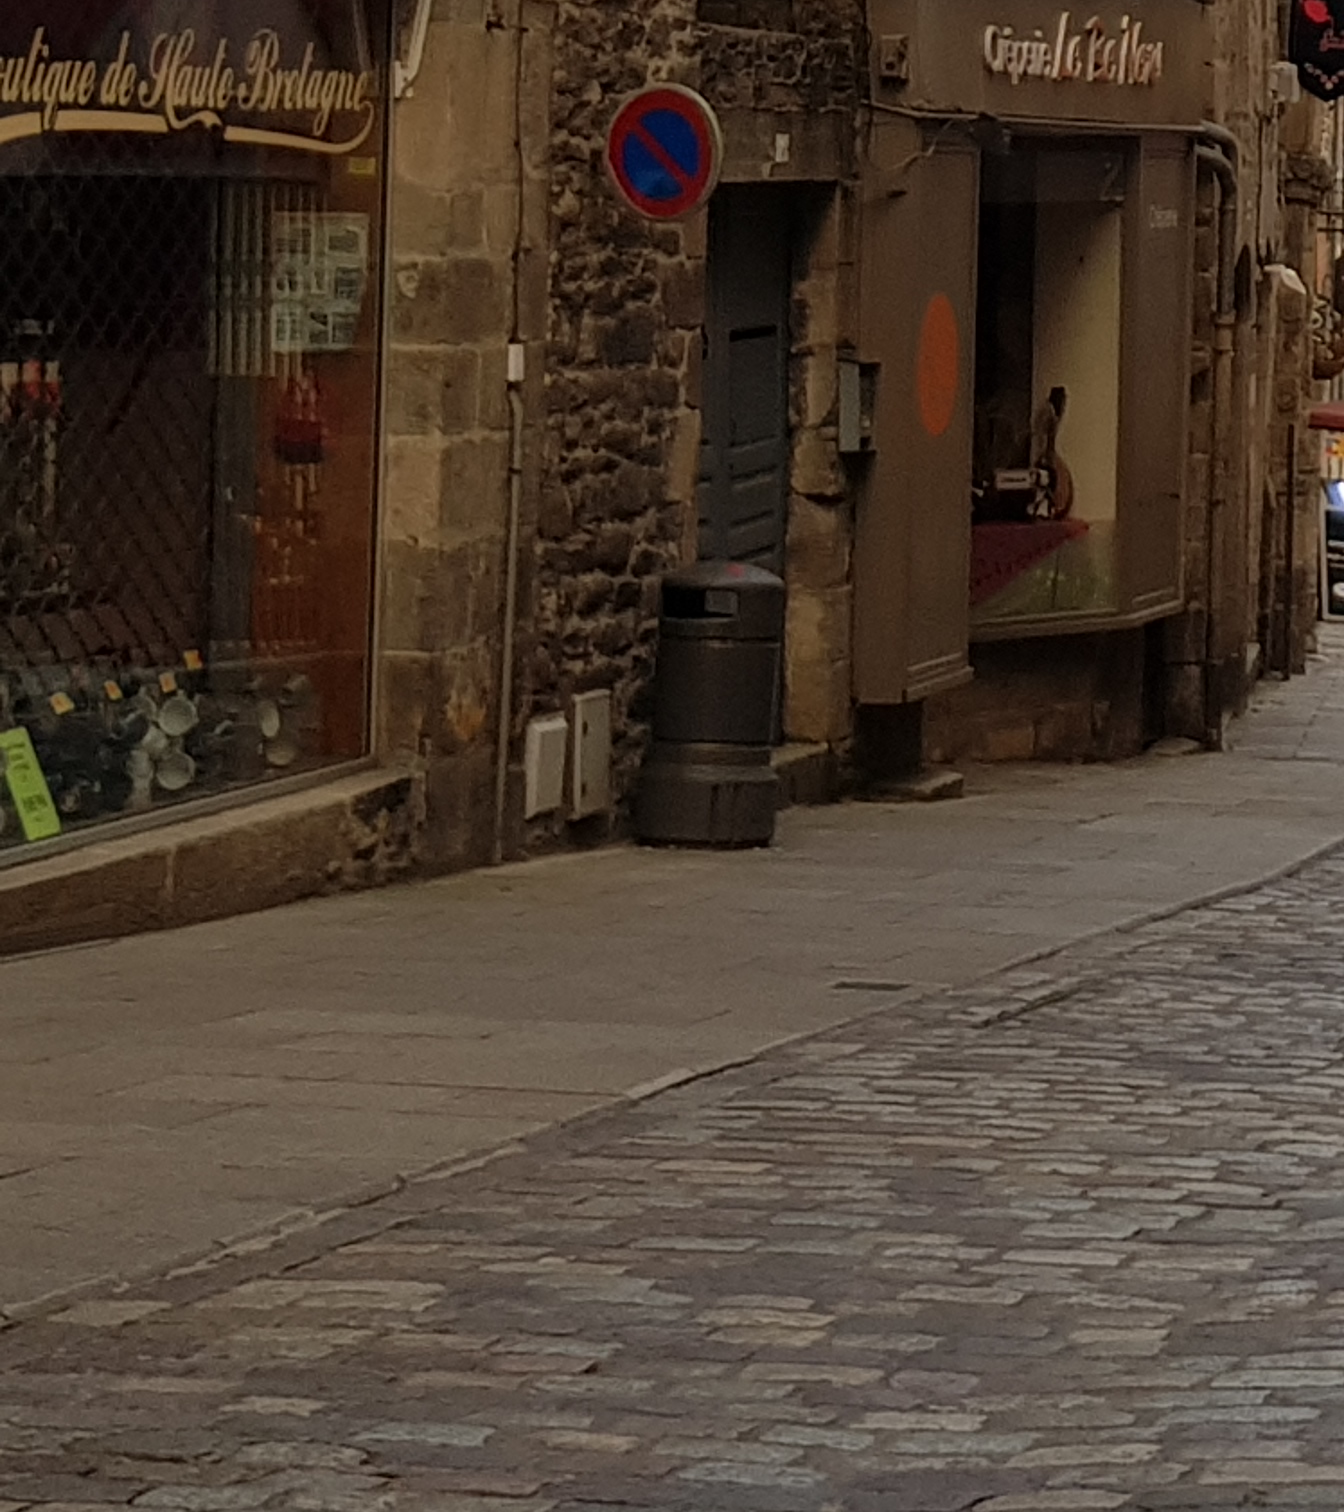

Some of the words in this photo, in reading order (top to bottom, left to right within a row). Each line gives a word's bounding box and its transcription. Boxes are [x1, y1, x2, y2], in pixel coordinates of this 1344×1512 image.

[100, 30, 137, 106] de
[138, 28, 236, 128] Haute
[237, 29, 374, 138] Bretagne
